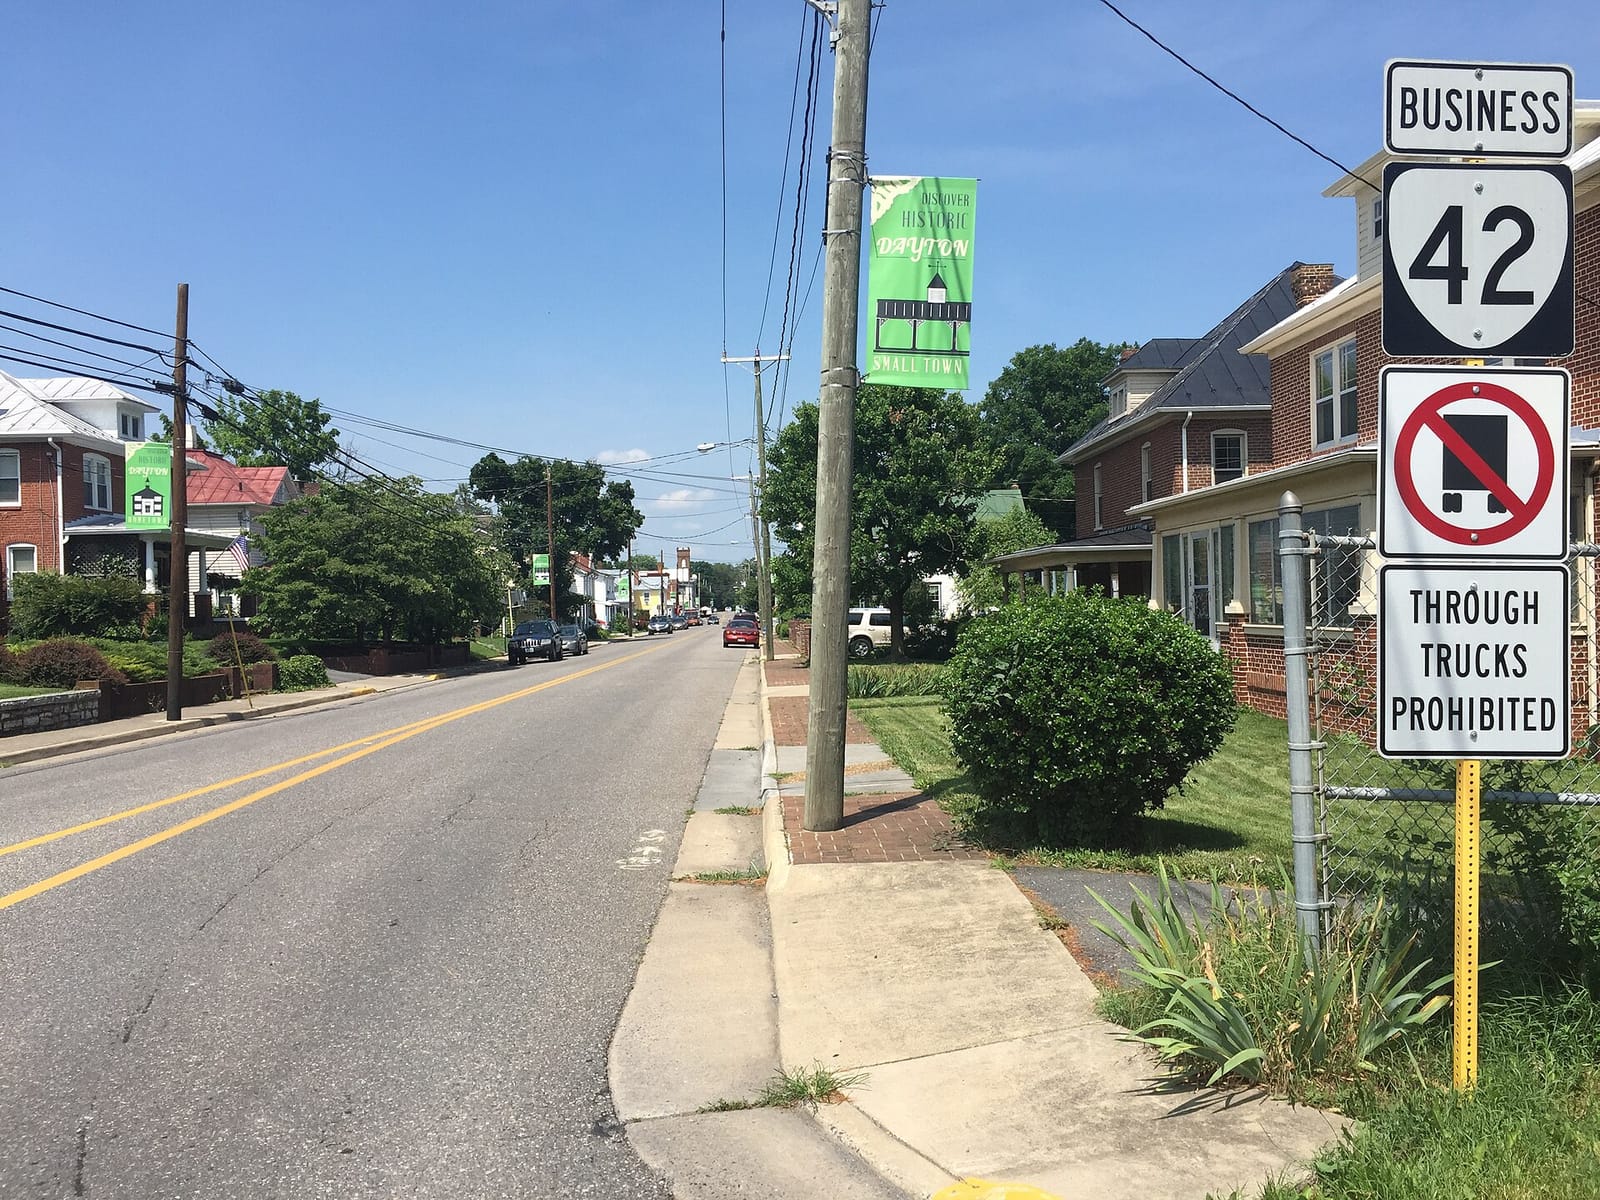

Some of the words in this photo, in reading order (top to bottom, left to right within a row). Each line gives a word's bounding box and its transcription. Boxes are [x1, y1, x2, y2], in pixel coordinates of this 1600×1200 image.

[1400, 87, 1561, 134] BUSINESS
[922, 192, 970, 207] DISCOVER
[902, 210, 969, 229] HISTORIC
[876, 236, 969, 263] DAYTON
[1409, 205, 1535, 305] 42
[872, 355, 918, 373] SMALL
[924, 357, 962, 374] TOWN
[128, 466, 169, 477] DAYTON
[1409, 590, 1539, 625] THROUGH
[1421, 643, 1527, 678] TRUCKS
[1392, 697, 1556, 731] PROHIBITED
